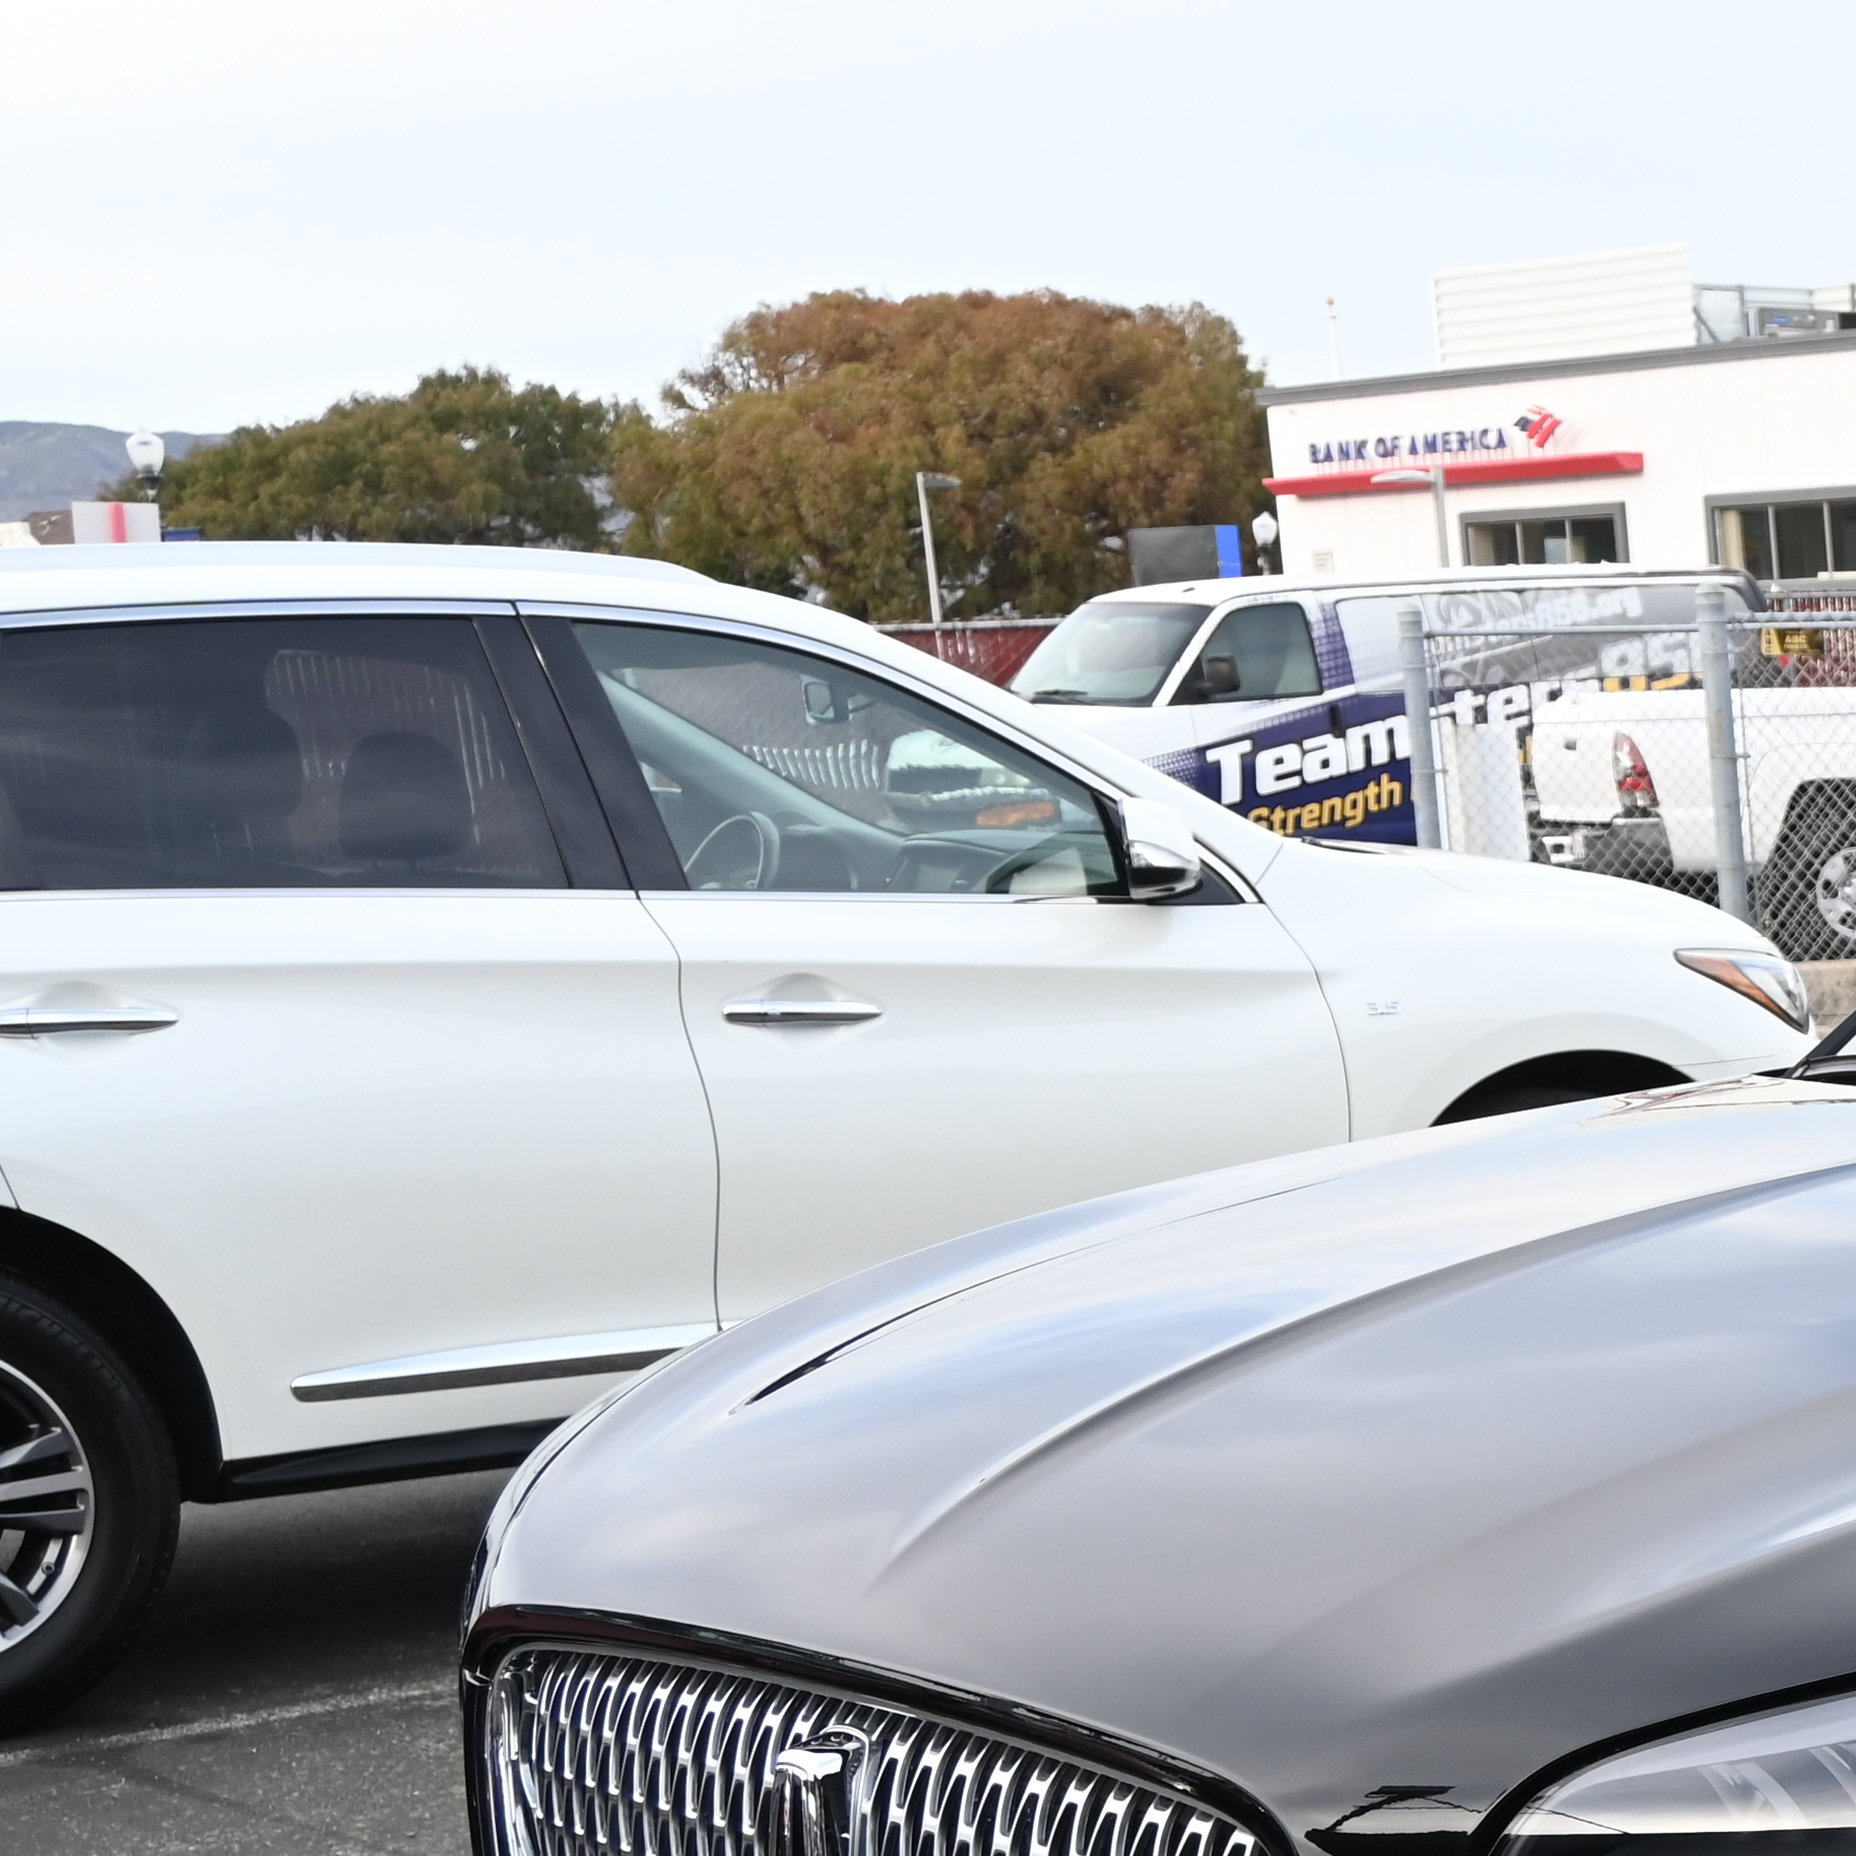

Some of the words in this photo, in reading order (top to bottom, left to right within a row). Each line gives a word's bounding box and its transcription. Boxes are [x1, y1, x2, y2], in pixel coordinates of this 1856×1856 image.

[1308, 440, 1368, 464] BANK
[1375, 437, 1402, 458] OF
[1408, 427, 1507, 455] AMERICA
[1247, 773, 1403, 835] Strength
